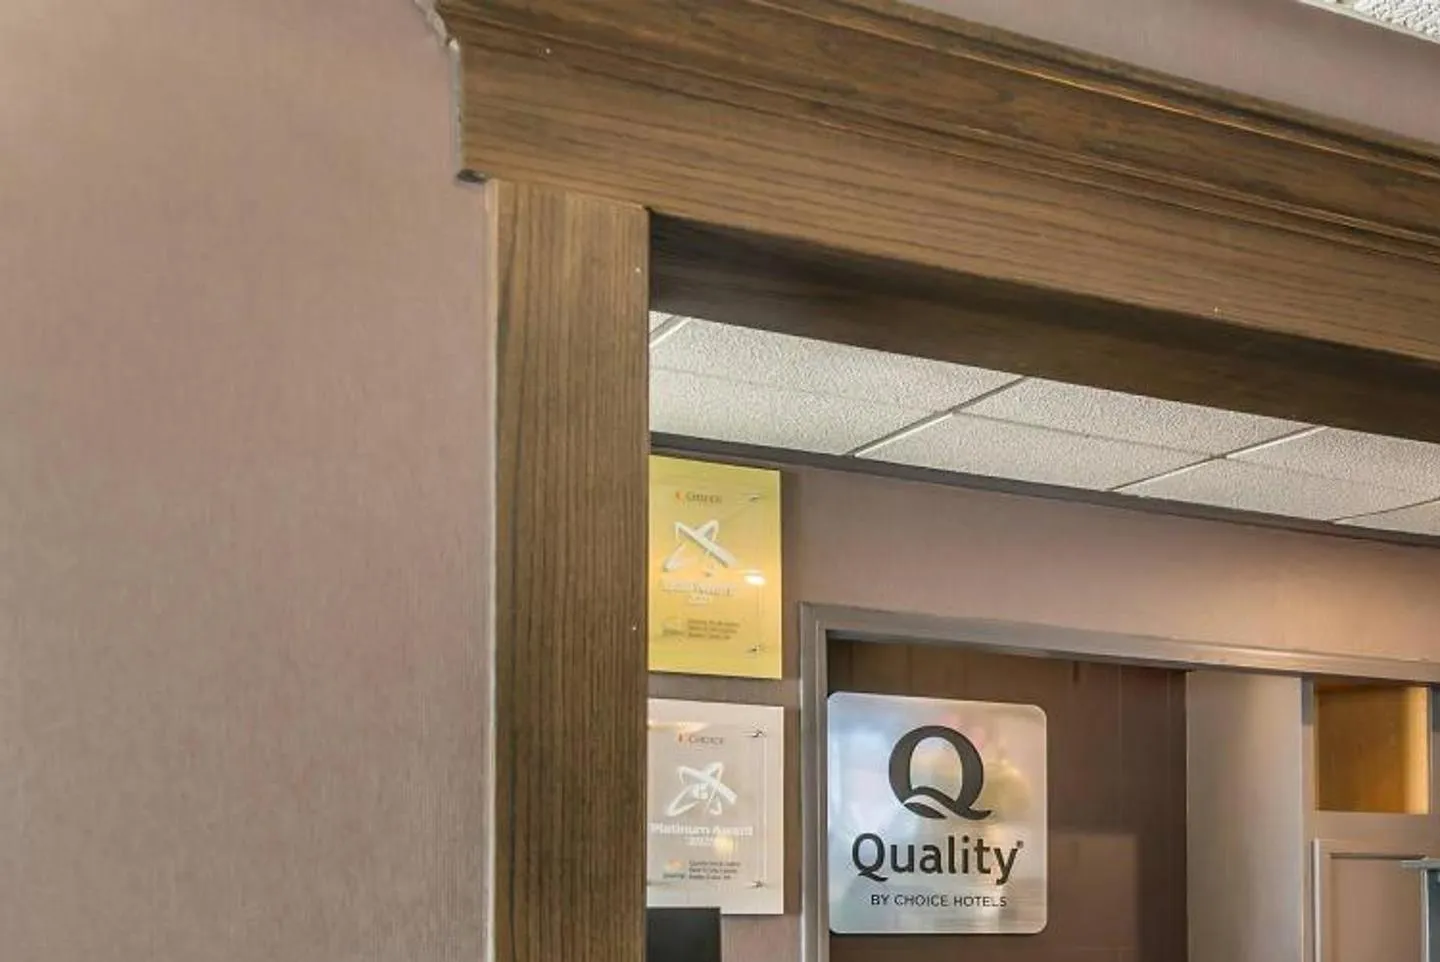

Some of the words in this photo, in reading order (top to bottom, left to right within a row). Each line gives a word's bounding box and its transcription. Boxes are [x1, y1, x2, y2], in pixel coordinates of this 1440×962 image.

[888, 725, 993, 820] Q
[852, 833, 1020, 886] Quality
[870, 894, 890, 906] BY
[894, 894, 949, 907] CHOICE
[953, 895, 1007, 908] HOTELS
